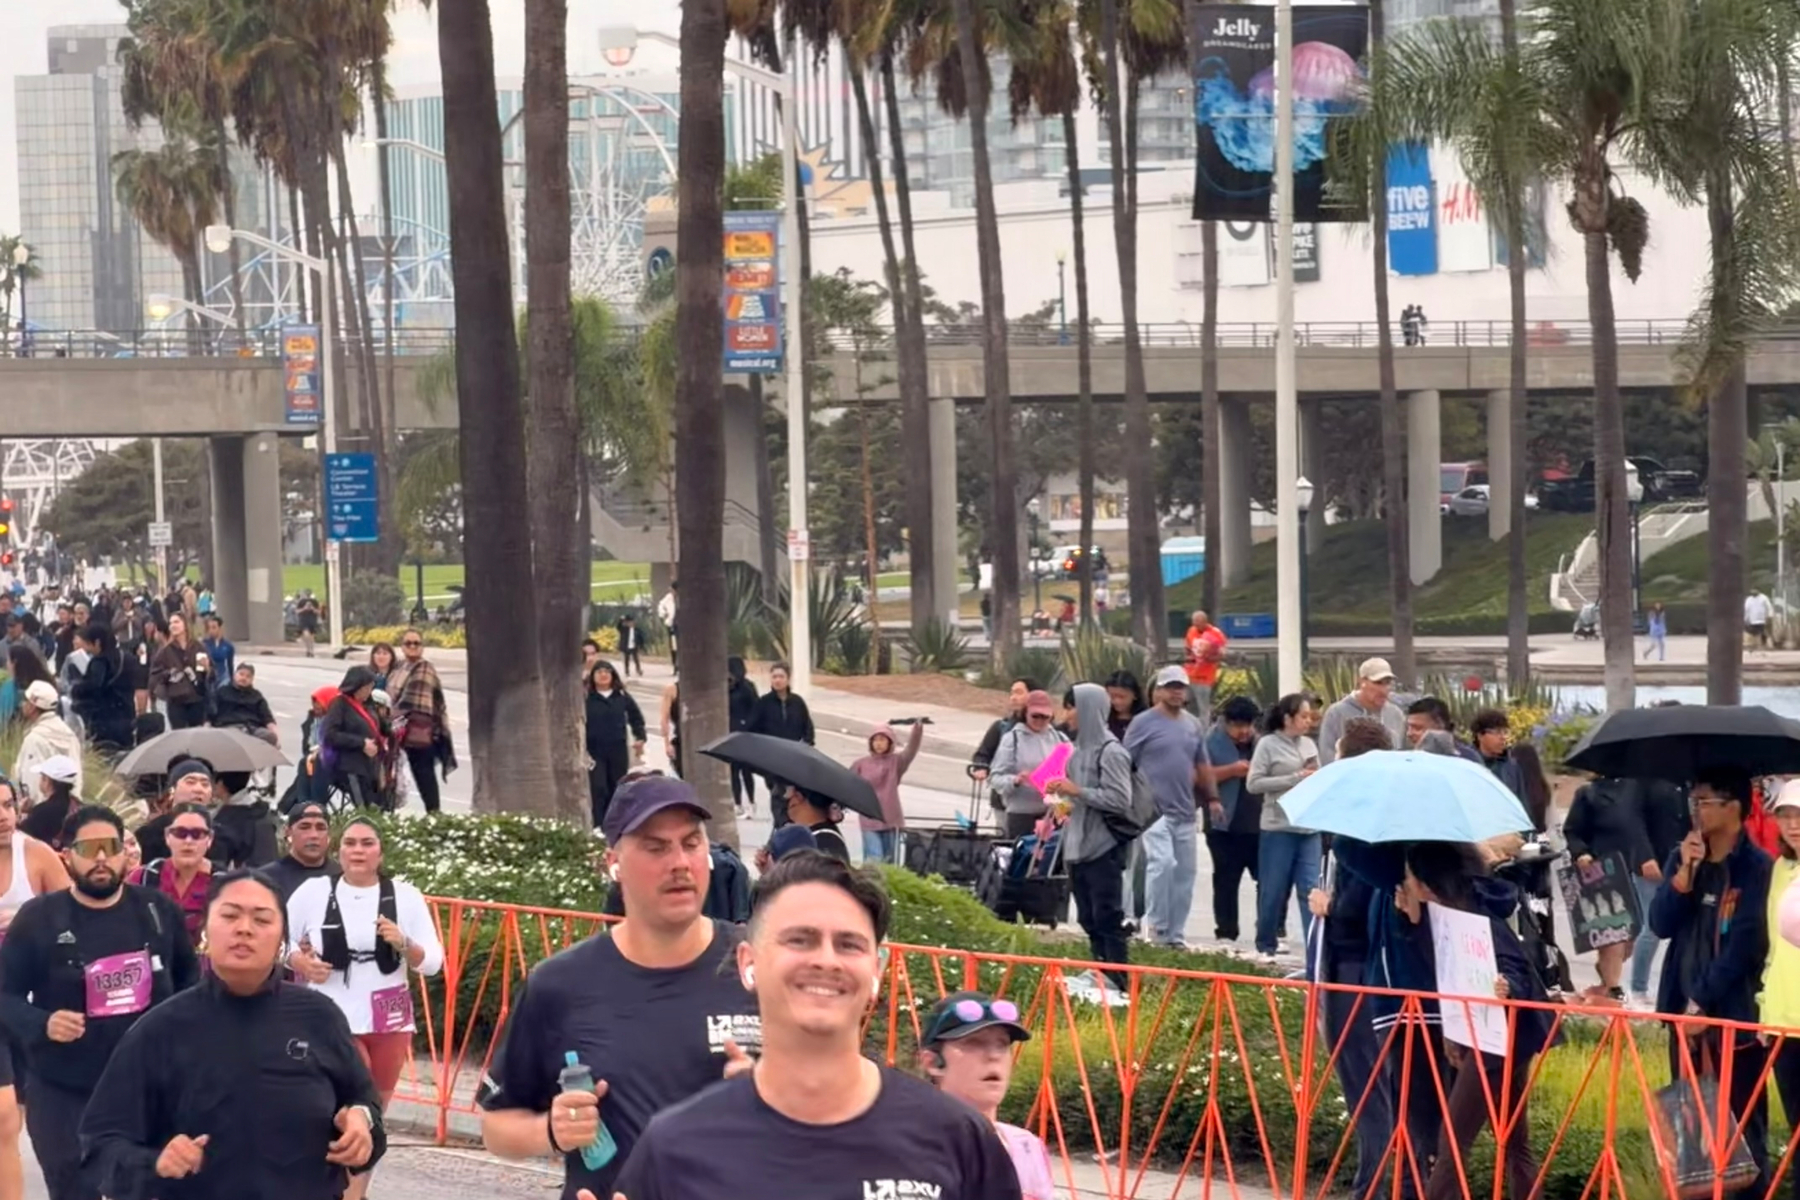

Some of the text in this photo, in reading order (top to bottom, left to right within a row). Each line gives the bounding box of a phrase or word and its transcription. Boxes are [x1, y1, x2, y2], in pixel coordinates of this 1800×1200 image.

[1212, 18, 1262, 42] Jelly
[1387, 185, 1429, 212] five
[95, 965, 143, 991] 13357
